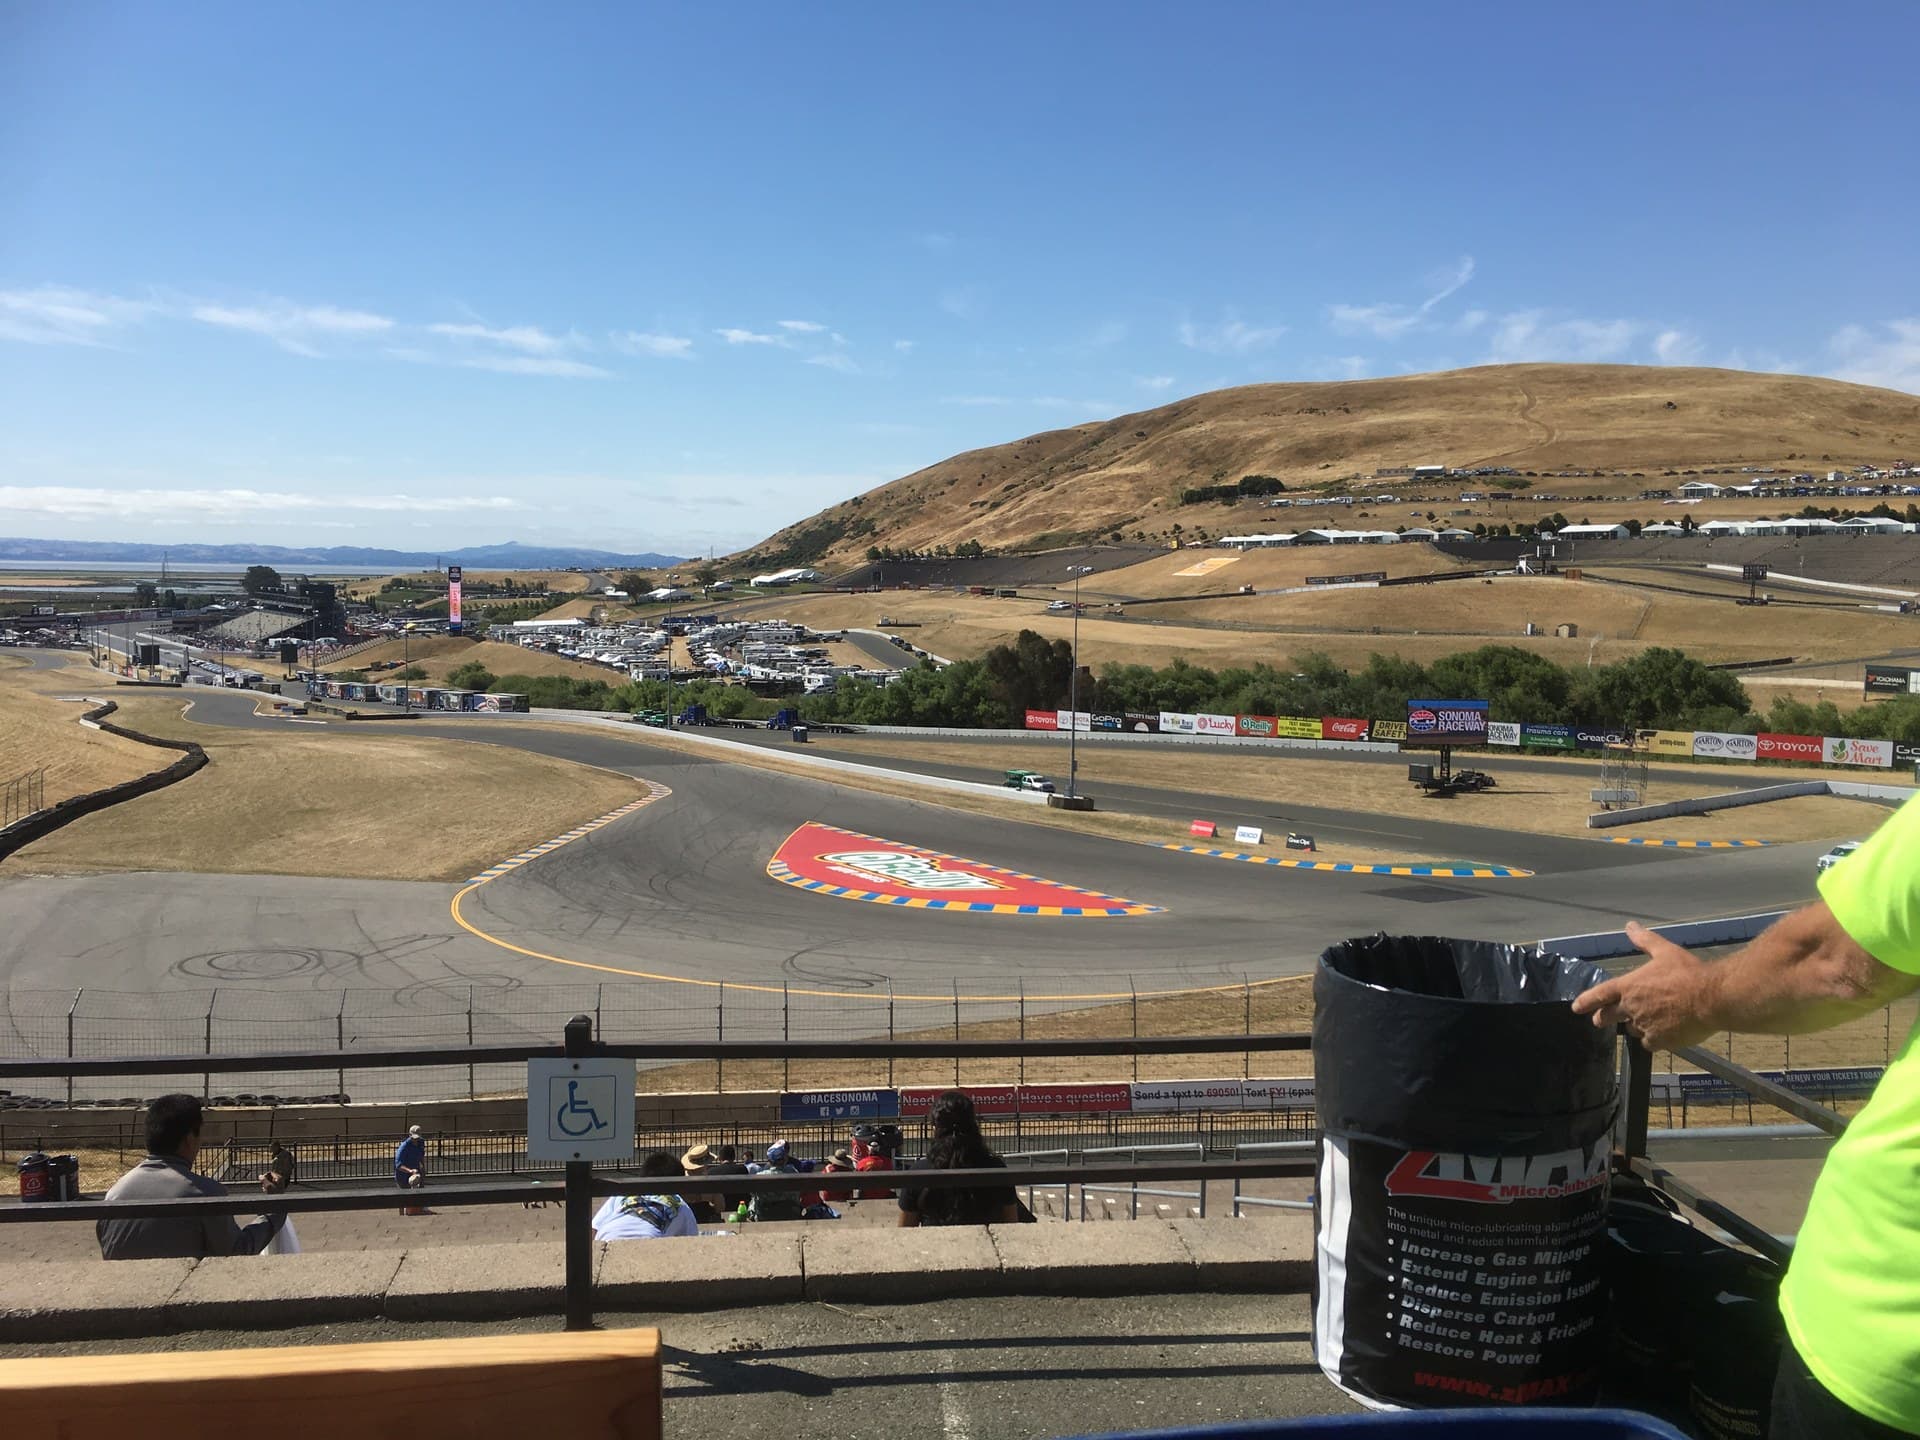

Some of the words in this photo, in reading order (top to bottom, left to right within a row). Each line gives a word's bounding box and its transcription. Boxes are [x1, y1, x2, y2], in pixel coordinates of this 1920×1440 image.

[1034, 716, 1056, 724] TOYOTA
[1069, 715, 1089, 723] TYOTA
[1091, 713, 1122, 723] GoPro
[1438, 711, 1482, 722] SONOMA
[1208, 717, 1234, 732] Lucky
[1379, 721, 1405, 730] DRIVE
[1438, 721, 1487, 732] RACEWAY
[1526, 727, 1552, 736] trauma
[1552, 729, 1569, 737] care
[1606, 734, 1624, 744] Clip
[1695, 735, 1723, 746] GARTON
[1726, 737, 1754, 748] GARTON
[1776, 741, 1821, 753] TOYOTA
[1850, 740, 1879, 752] Save
[1849, 751, 1882, 765] Mart
[1238, 831, 1258, 839] GEICO
[1786, 1073, 1811, 1083] RENEW
[1812, 1073, 1831, 1082] YOUR
[1832, 1071, 1858, 1081] TICKETS
[801, 1092, 878, 1104] @RACESONOMA
[1020, 1092, 1052, 1104] Have
[1055, 1093, 1063, 1103] a
[1066, 1090, 1128, 1105] question?
[1134, 1090, 1161, 1101] Send
[1164, 1091, 1170, 1099] a
[1172, 1090, 1192, 1100] text
[1194, 1089, 1204, 1098] to
[1206, 1088, 1240, 1098] 69050!
[1245, 1088, 1267, 1098] Text
[1269, 1087, 1286, 1098] FYI
[902, 1094, 935, 1106] Need
[1387, 1206, 1407, 1220] The
[1409, 1213, 1448, 1228] unique
[1449, 1220, 1542, 1234] micro-lubricating
[1387, 1218, 1407, 1233] into
[1409, 1226, 1441, 1241] metal
[1442, 1232, 1465, 1245] and
[1467, 1236, 1505, 1248] reduce
[1506, 1234, 1549, 1247] harmful
[1401, 1239, 1486, 1267] Increase
[1493, 1252, 1528, 1267] Gas
[1534, 1244, 1592, 1265] Mileage
[1401, 1258, 1469, 1283] Extend
[1474, 1271, 1538, 1290] Engine
[1543, 1269, 1572, 1285] Life
[1401, 1276, 1473, 1304] Reduce
[1480, 1290, 1562, 1308] Emission
[1401, 1294, 1487, 1325] Disperse
[1493, 1310, 1556, 1327] Carbon
[1399, 1313, 1472, 1341] Reduce
[1478, 1329, 1525, 1345] Heat
[1530, 1330, 1544, 1345] &
[1547, 1315, 1594, 1342] Friction
[1397, 1332, 1475, 1360] Restore
[1482, 1348, 1544, 1366] Power
